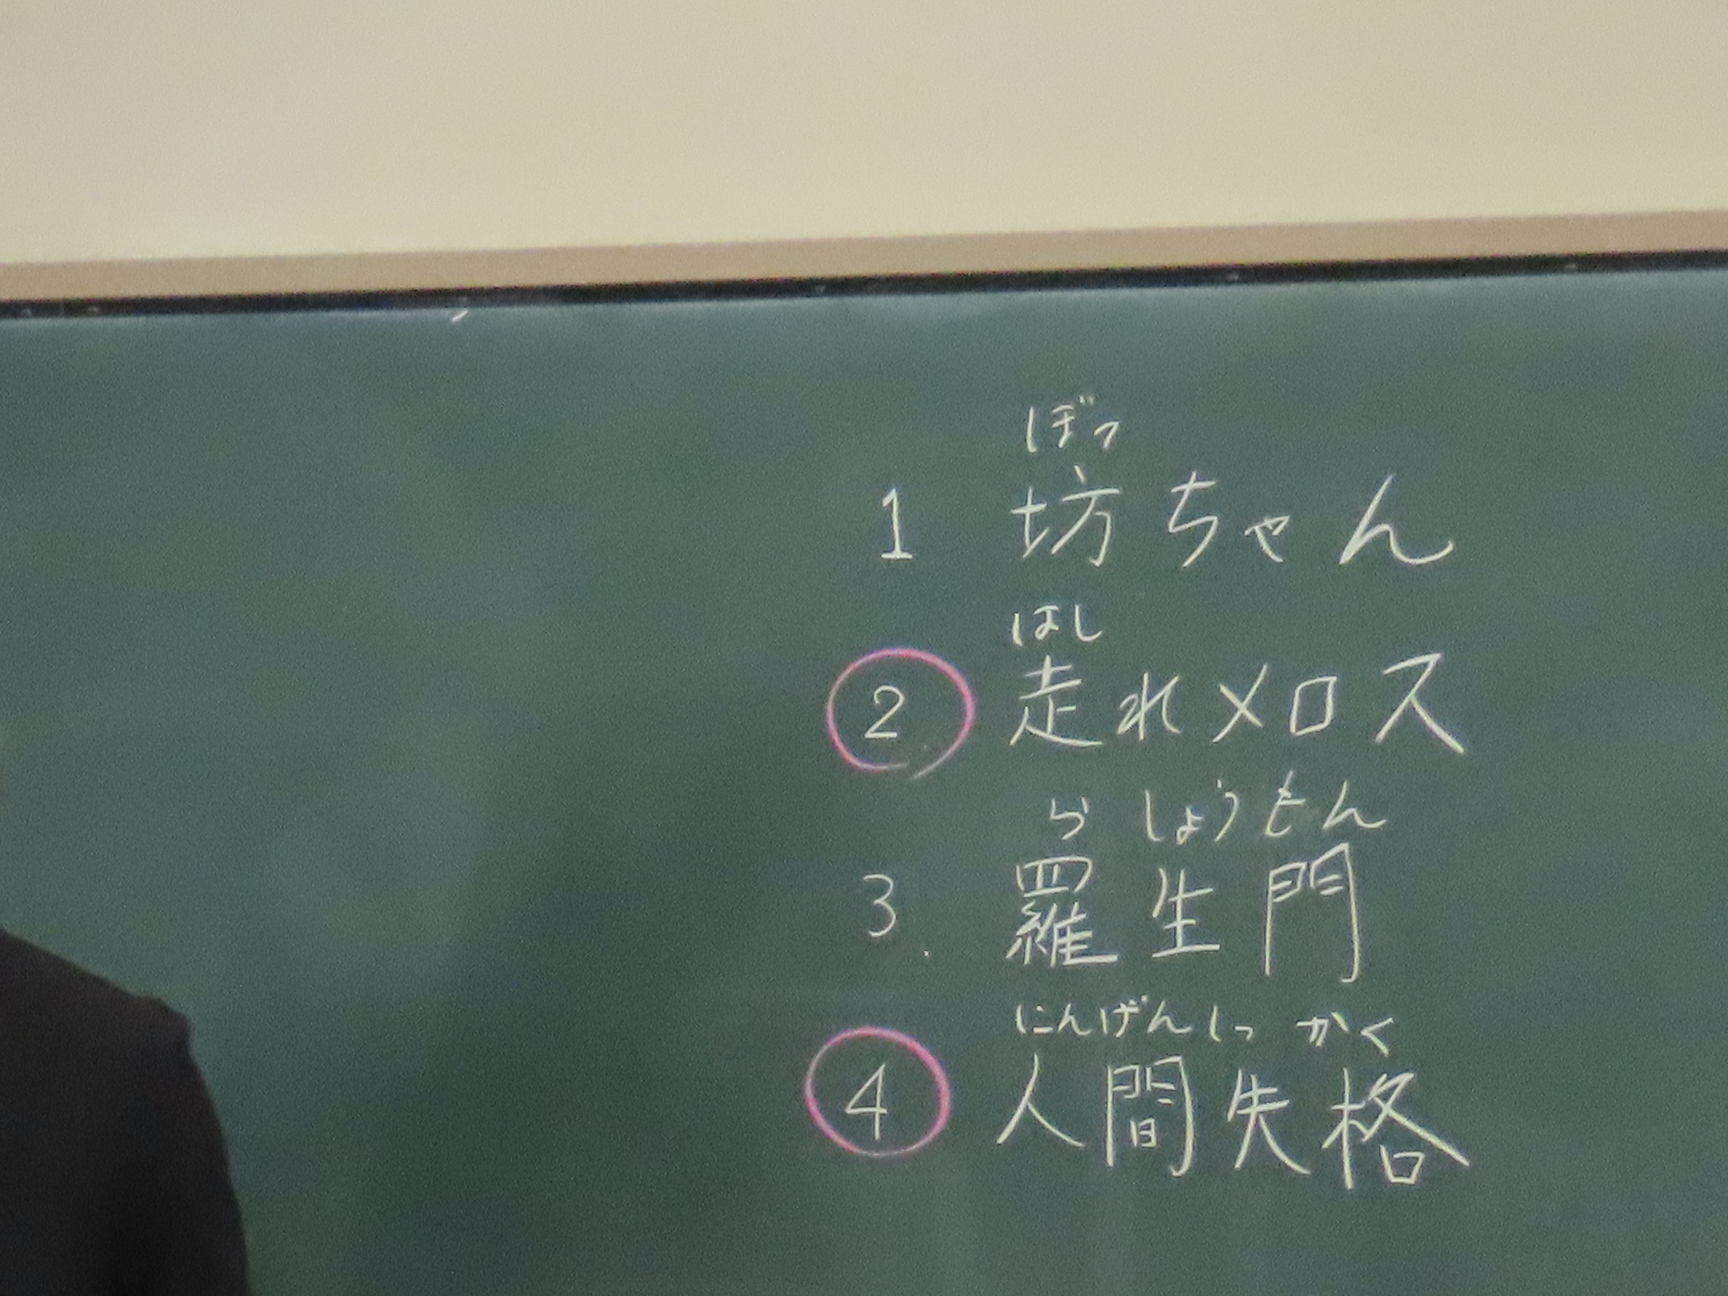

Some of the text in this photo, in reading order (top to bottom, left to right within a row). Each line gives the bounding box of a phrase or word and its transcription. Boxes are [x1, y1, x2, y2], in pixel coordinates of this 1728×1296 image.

[880, 464, 1456, 568] 1 坊ちゃん
[1010, 602, 1105, 648] はし
[863, 653, 1467, 755] 2 走れメロス
[1049, 797, 1090, 840] ら
[1005, 842, 1362, 985] 羅生門
[844, 1052, 1471, 1190] 4 人間失格
